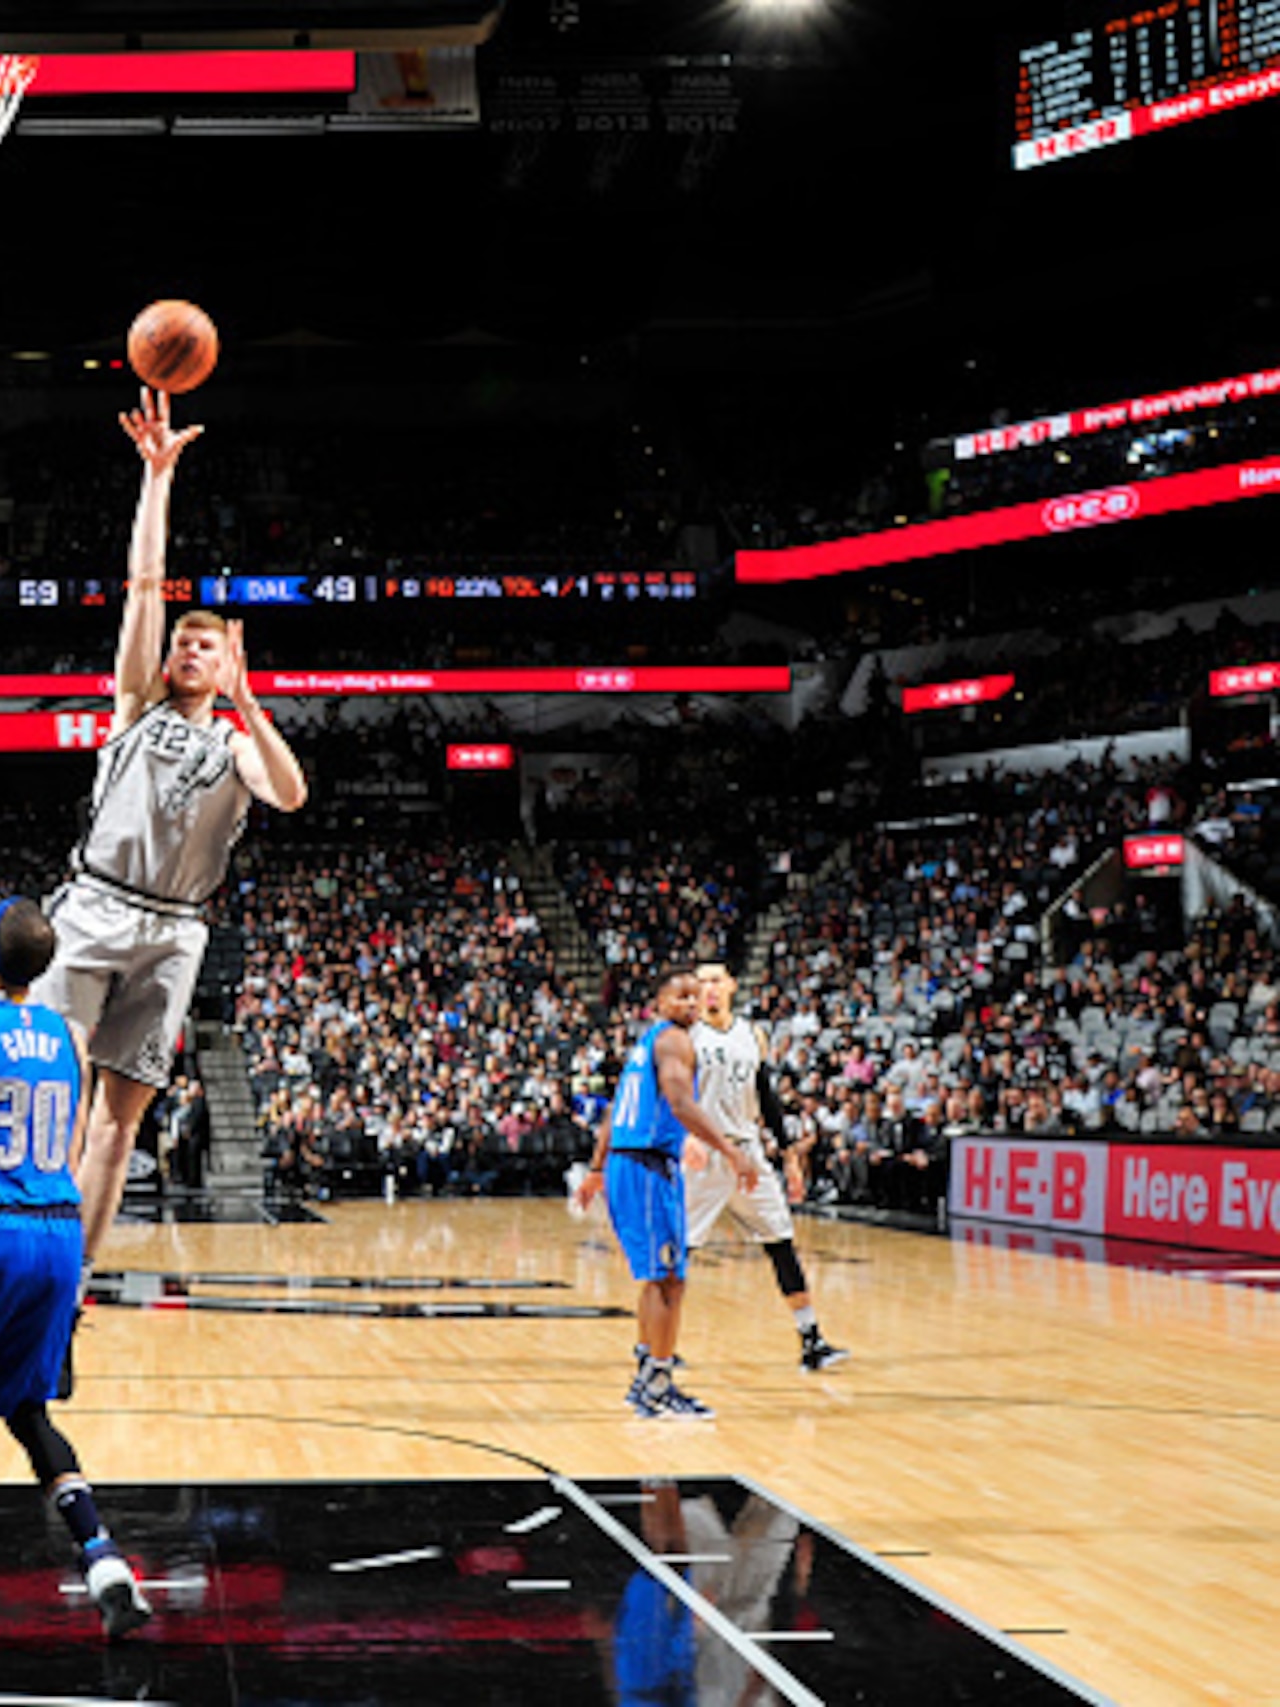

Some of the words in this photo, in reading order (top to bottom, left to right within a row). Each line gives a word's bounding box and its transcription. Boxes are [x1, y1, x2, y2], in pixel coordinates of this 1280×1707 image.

[19, 579, 59, 606] 59
[247, 580, 294, 601] DAL
[313, 576, 357, 601] 49
[147, 720, 190, 754] 42
[1123, 1155, 1208, 1224] Here
